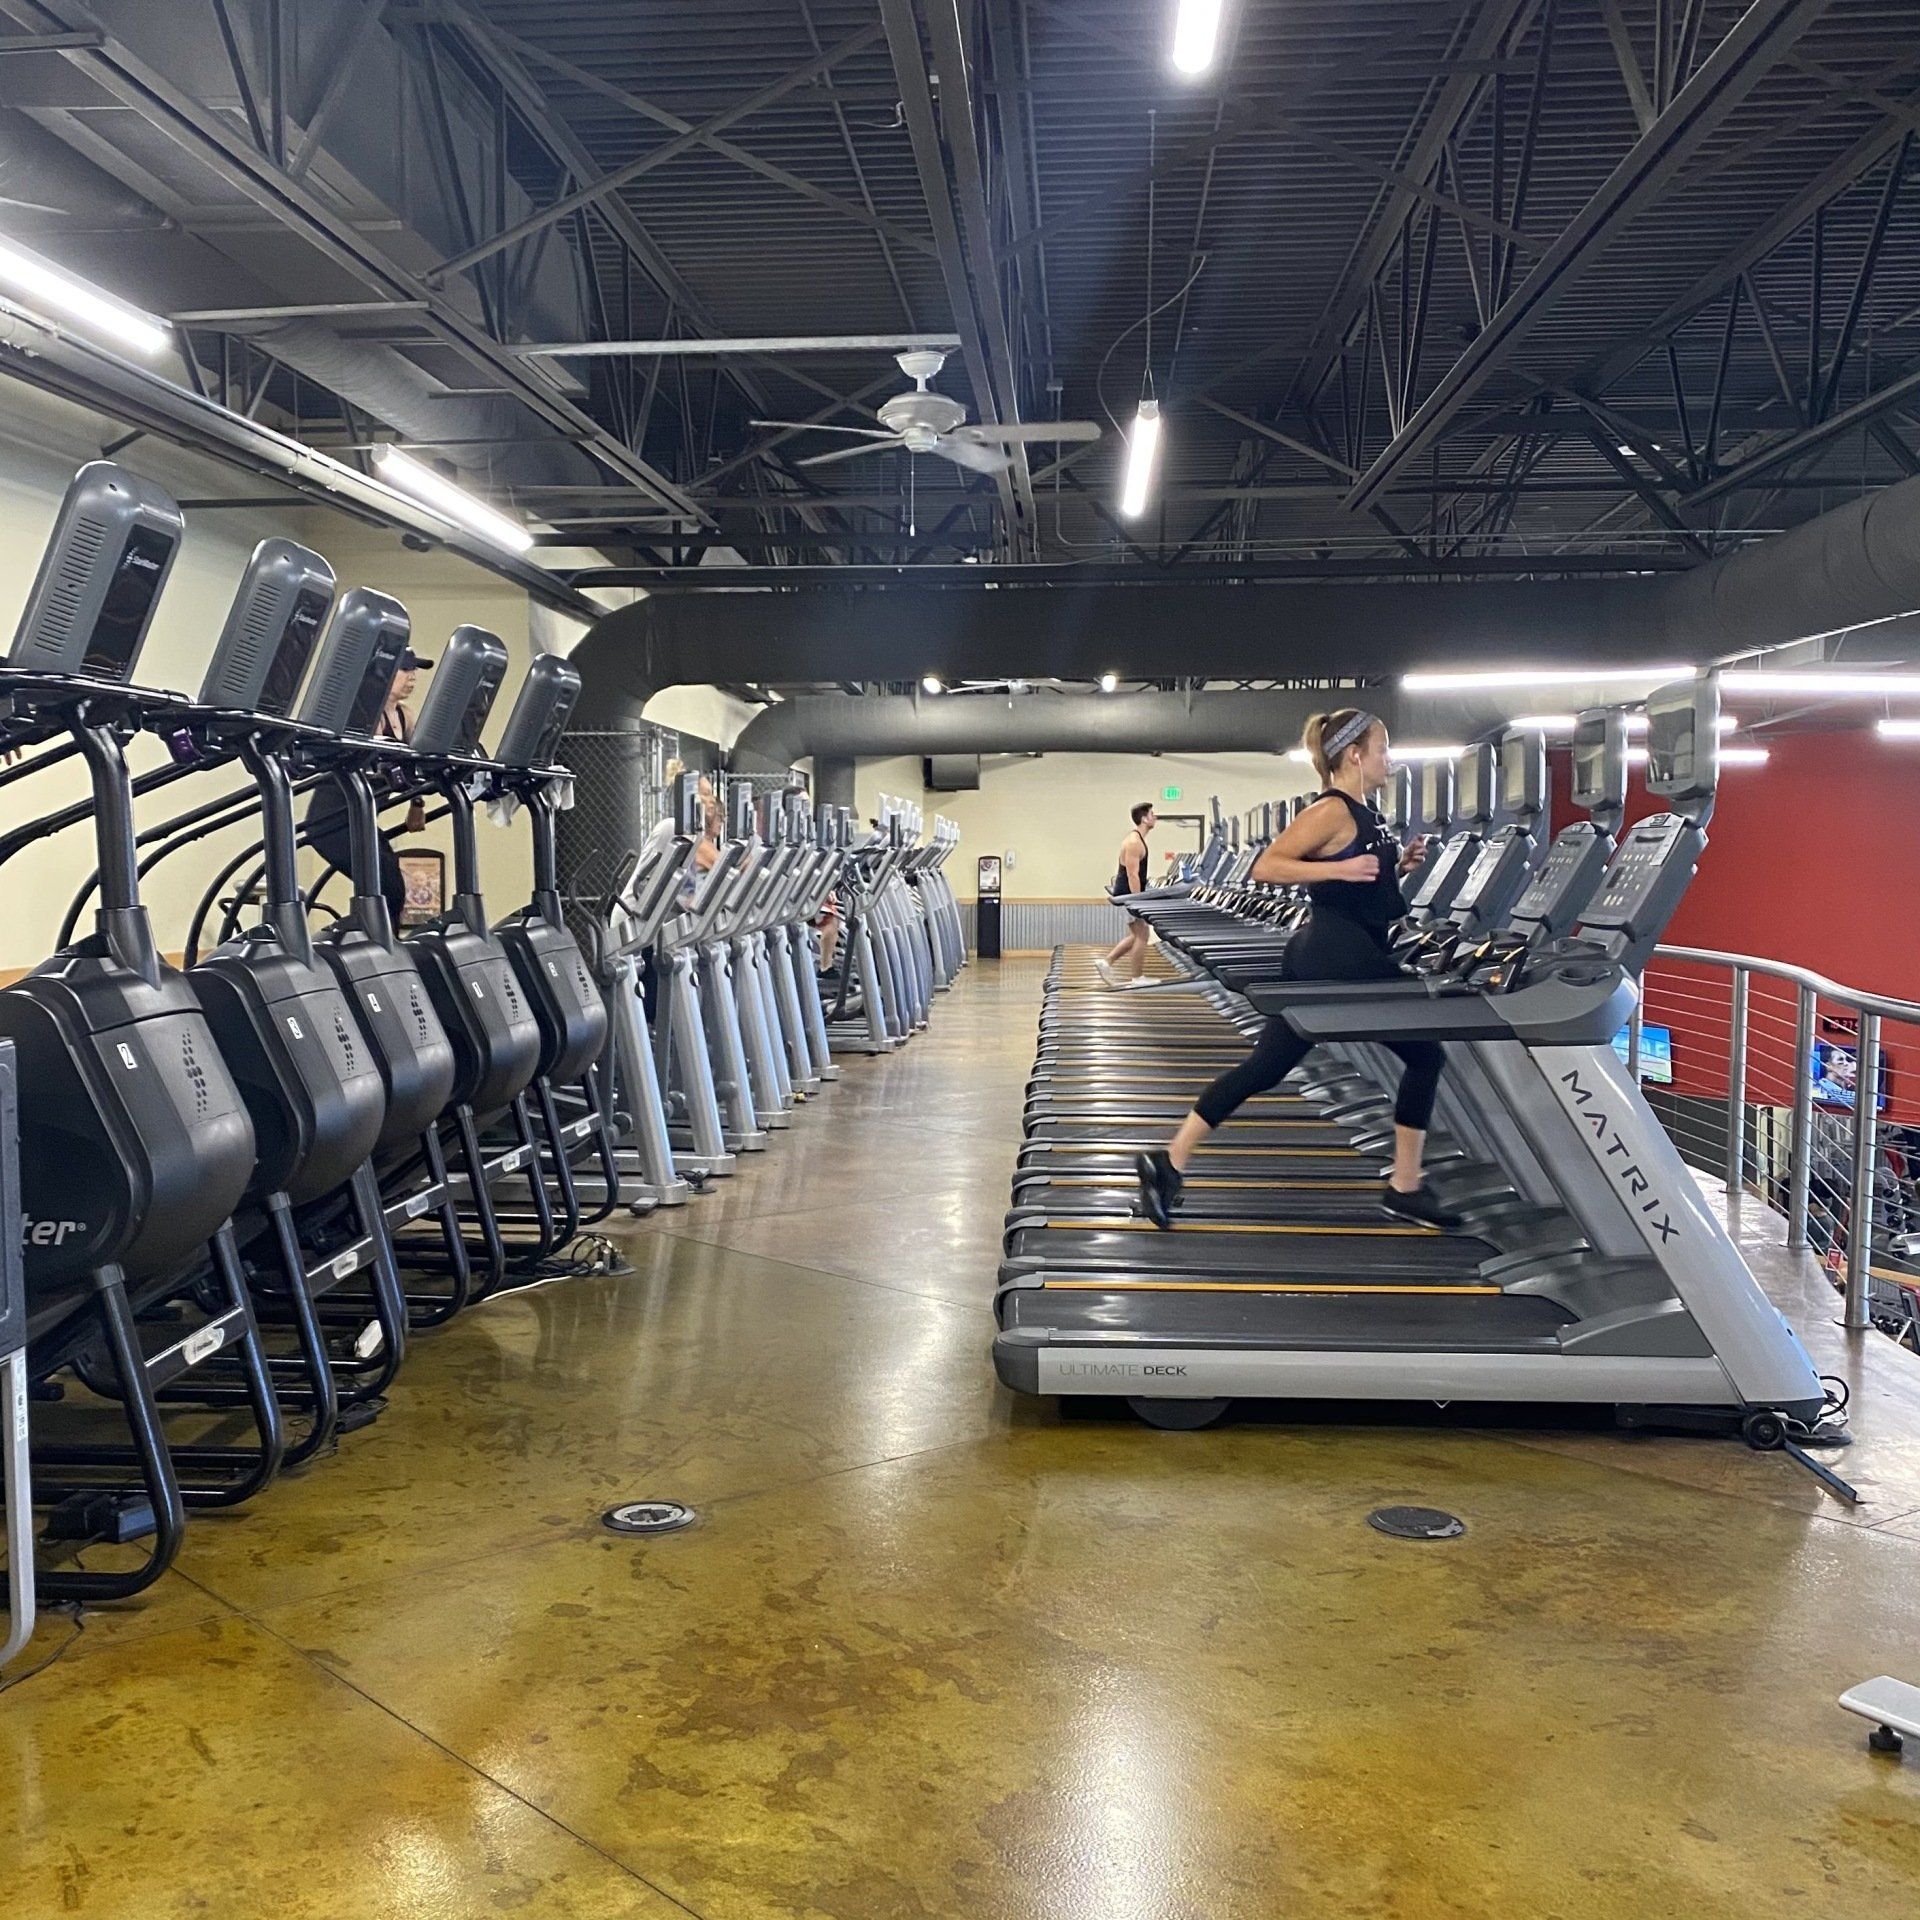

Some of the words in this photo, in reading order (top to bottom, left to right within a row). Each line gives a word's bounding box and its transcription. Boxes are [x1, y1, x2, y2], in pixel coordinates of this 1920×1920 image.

[120, 1046, 134, 1065] 2
[1561, 1069, 1681, 1244] MATRIX
[1059, 1364, 1140, 1376] ULTIMATE
[1143, 1365, 1188, 1377] DECK
